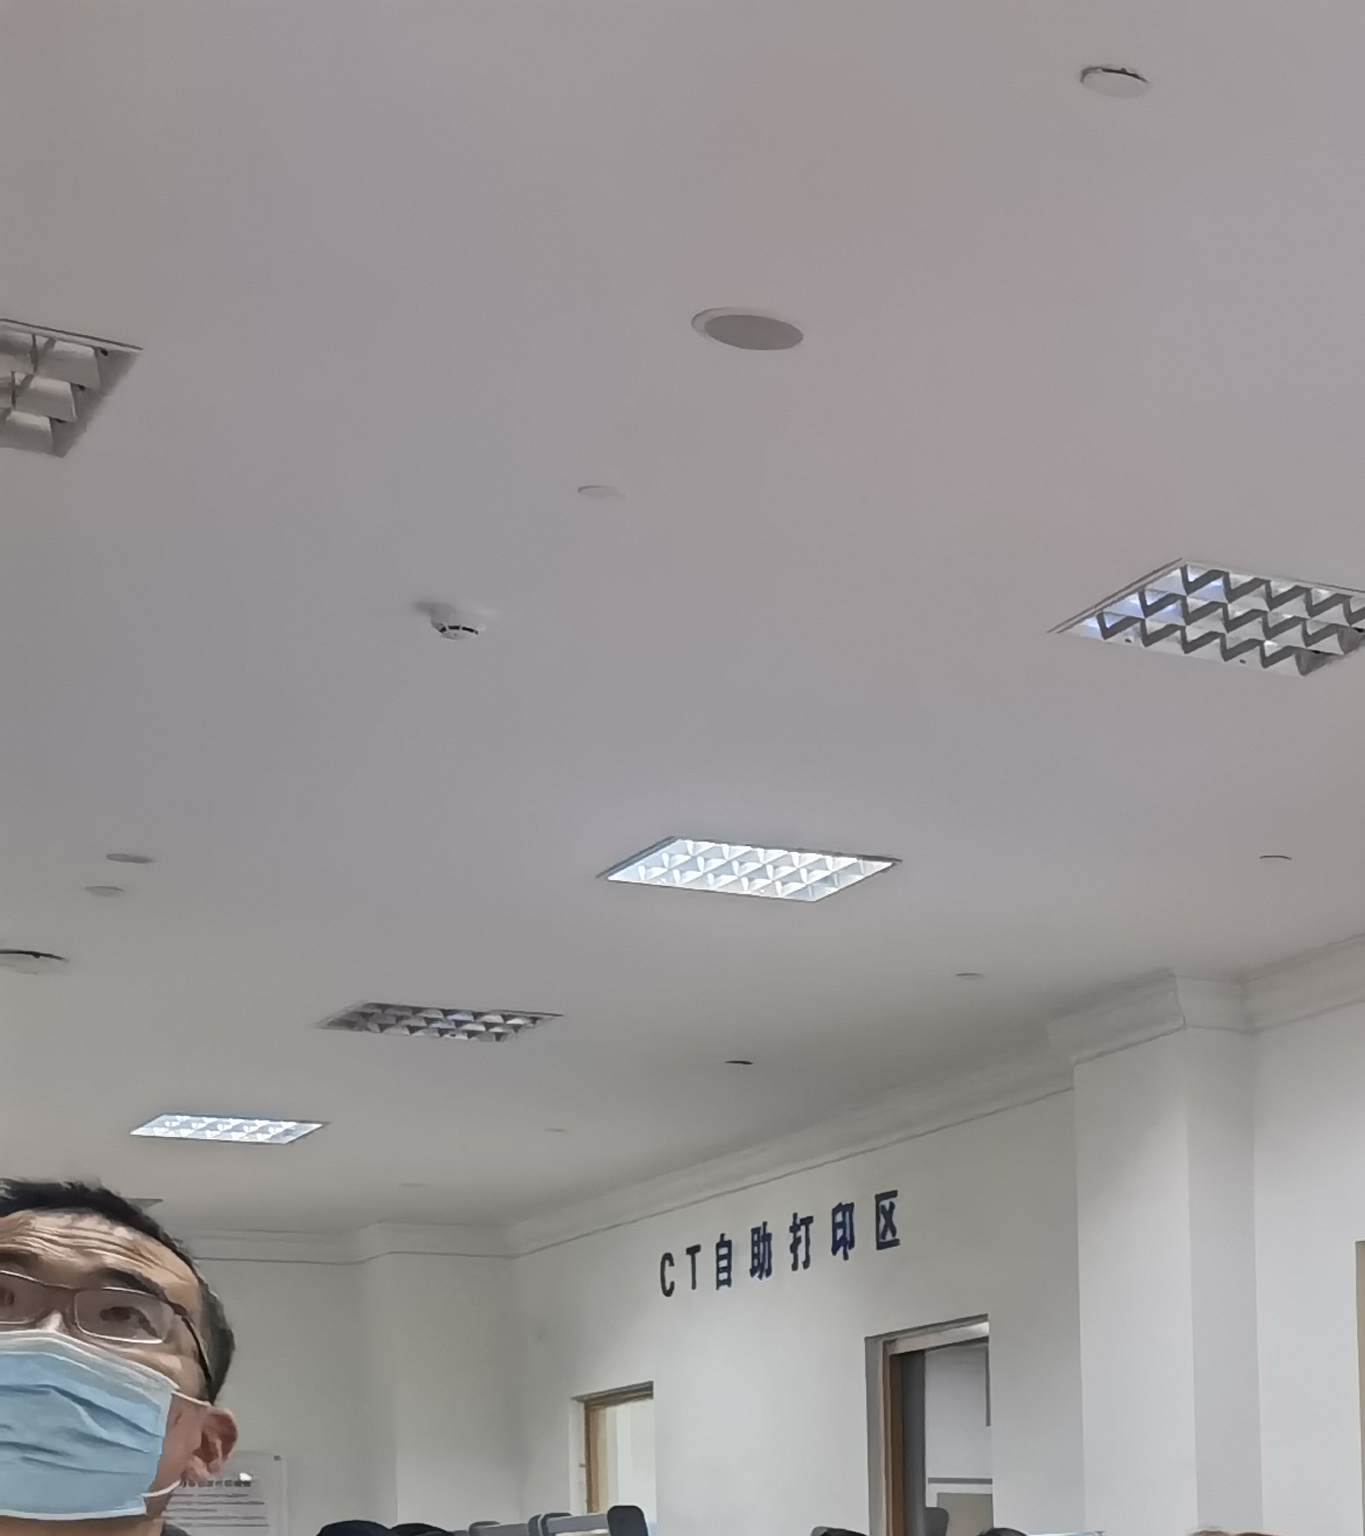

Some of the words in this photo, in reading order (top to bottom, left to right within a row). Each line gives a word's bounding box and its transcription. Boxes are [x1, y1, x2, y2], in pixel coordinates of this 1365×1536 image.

[660, 1190, 900, 1298] CT自助打印区
